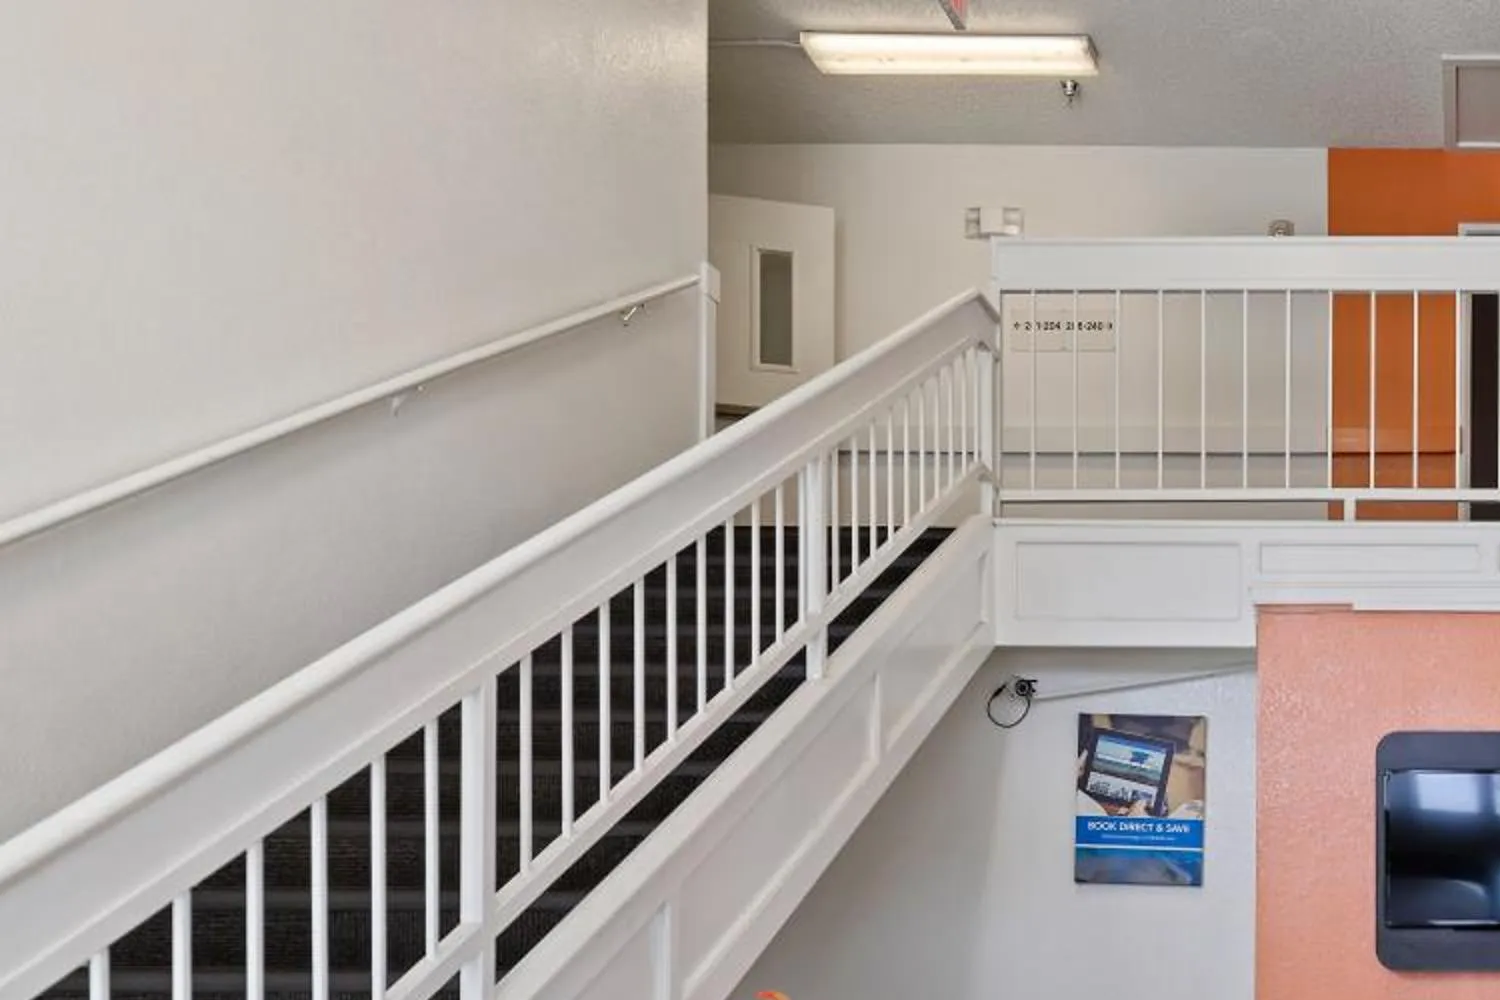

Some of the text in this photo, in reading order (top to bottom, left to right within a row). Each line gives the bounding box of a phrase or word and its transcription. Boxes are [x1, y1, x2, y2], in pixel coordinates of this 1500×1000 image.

[1087, 821, 1190, 834] BOOK DIRECT & SAVE
